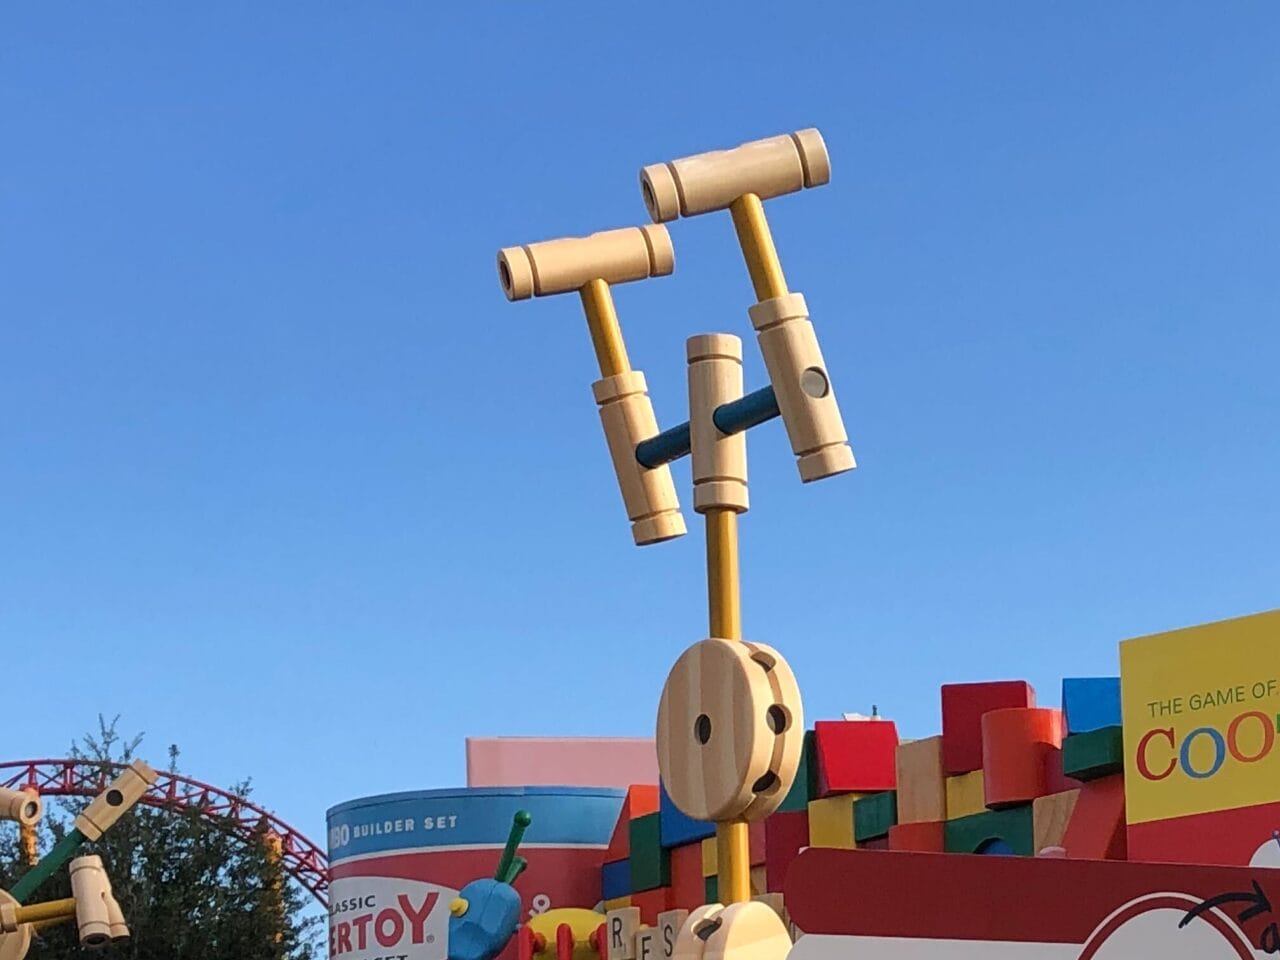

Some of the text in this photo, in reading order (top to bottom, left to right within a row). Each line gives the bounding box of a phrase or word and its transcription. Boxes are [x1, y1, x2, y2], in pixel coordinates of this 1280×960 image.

[1147, 697, 1183, 718] THE
[1188, 685, 1245, 711] GAME
[353, 818, 415, 839] BUILDER
[424, 815, 458, 830] SET
